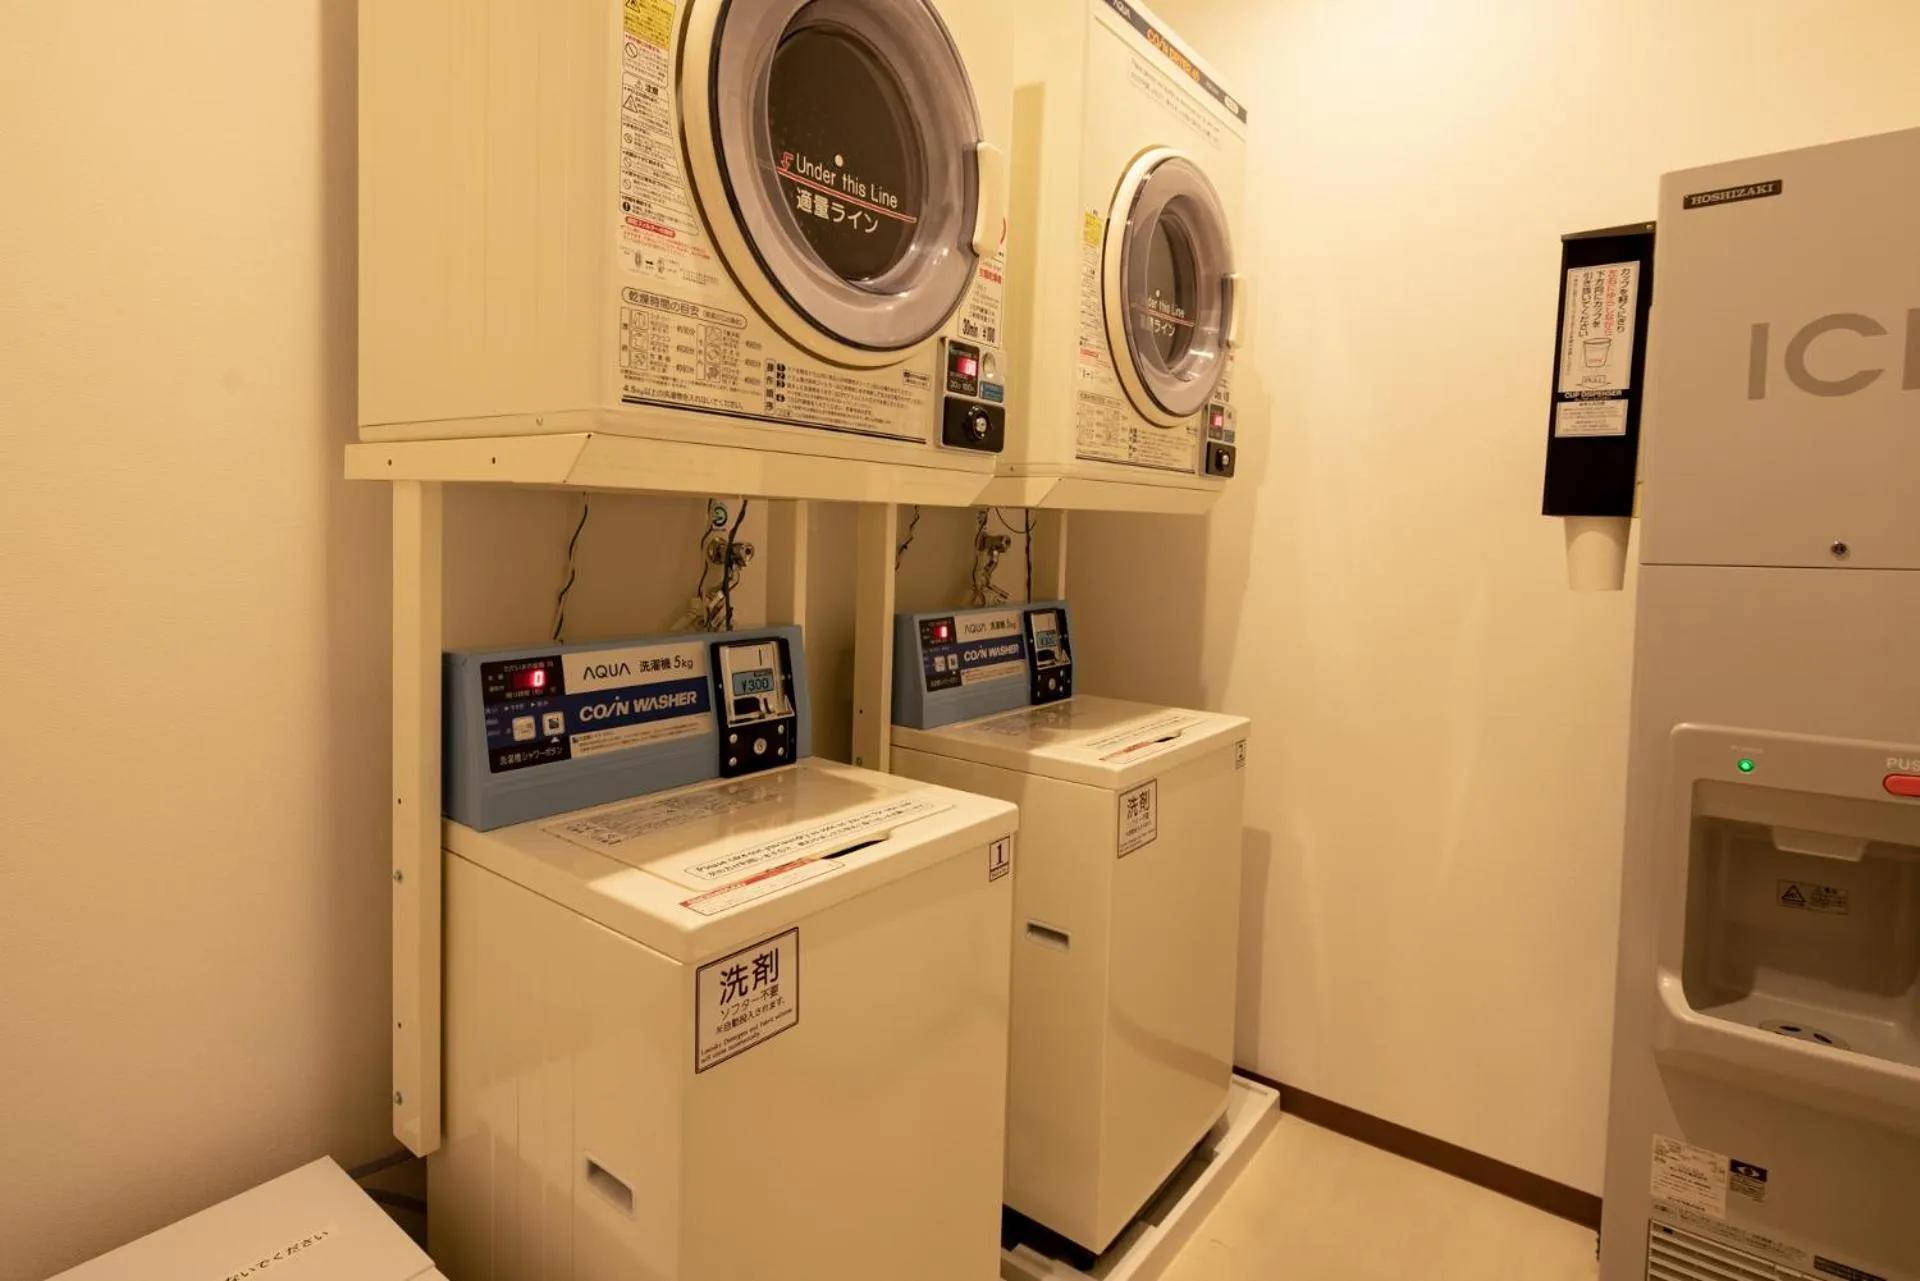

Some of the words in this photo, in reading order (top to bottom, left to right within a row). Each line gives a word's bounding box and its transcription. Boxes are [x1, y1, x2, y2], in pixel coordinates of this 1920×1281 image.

[796, 153, 836, 185] Under
[842, 174, 866, 198] this
[871, 184, 898, 208] Line
[1690, 183, 1774, 205] HOSHIZAKI
[796, 187, 878, 233] 適量ライン
[1747, 308, 1920, 400] IC
[533, 670, 545, 687] 0
[583, 662, 631, 681] AQUA
[639, 657, 671, 673] 洗濯機
[673, 655, 694, 670] 5kg
[741, 676, 769, 691] ¥300
[579, 695, 629, 722] COIN
[633, 691, 698, 714] WASHER
[996, 844, 1004, 866] 1
[720, 948, 779, 1005] 洗剤
[721, 984, 779, 1020] ソフター不要
